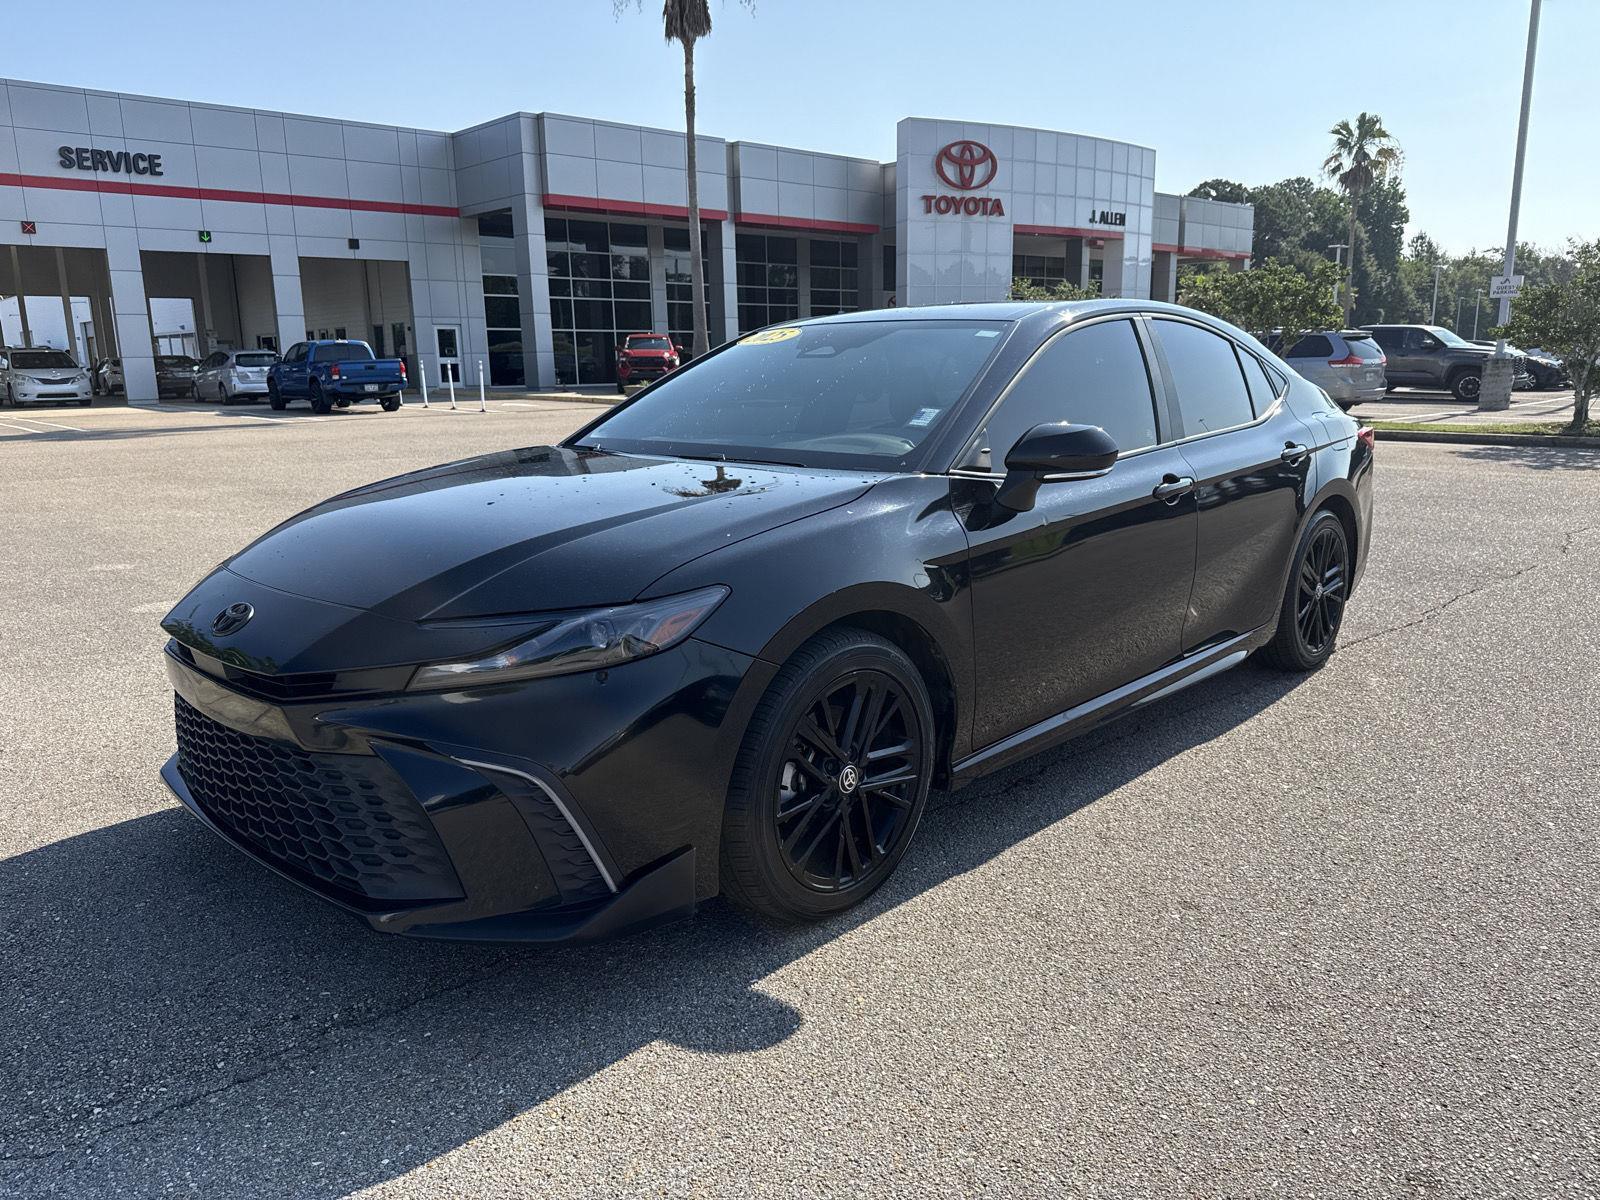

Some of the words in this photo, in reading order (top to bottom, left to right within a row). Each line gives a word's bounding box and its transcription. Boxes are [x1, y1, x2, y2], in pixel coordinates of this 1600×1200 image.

[58, 146, 164, 176] SERVICE
[922, 195, 1005, 216] TOYOTA
[1089, 209, 1098, 224] J.
[1099, 210, 1126, 226] ALLEN
